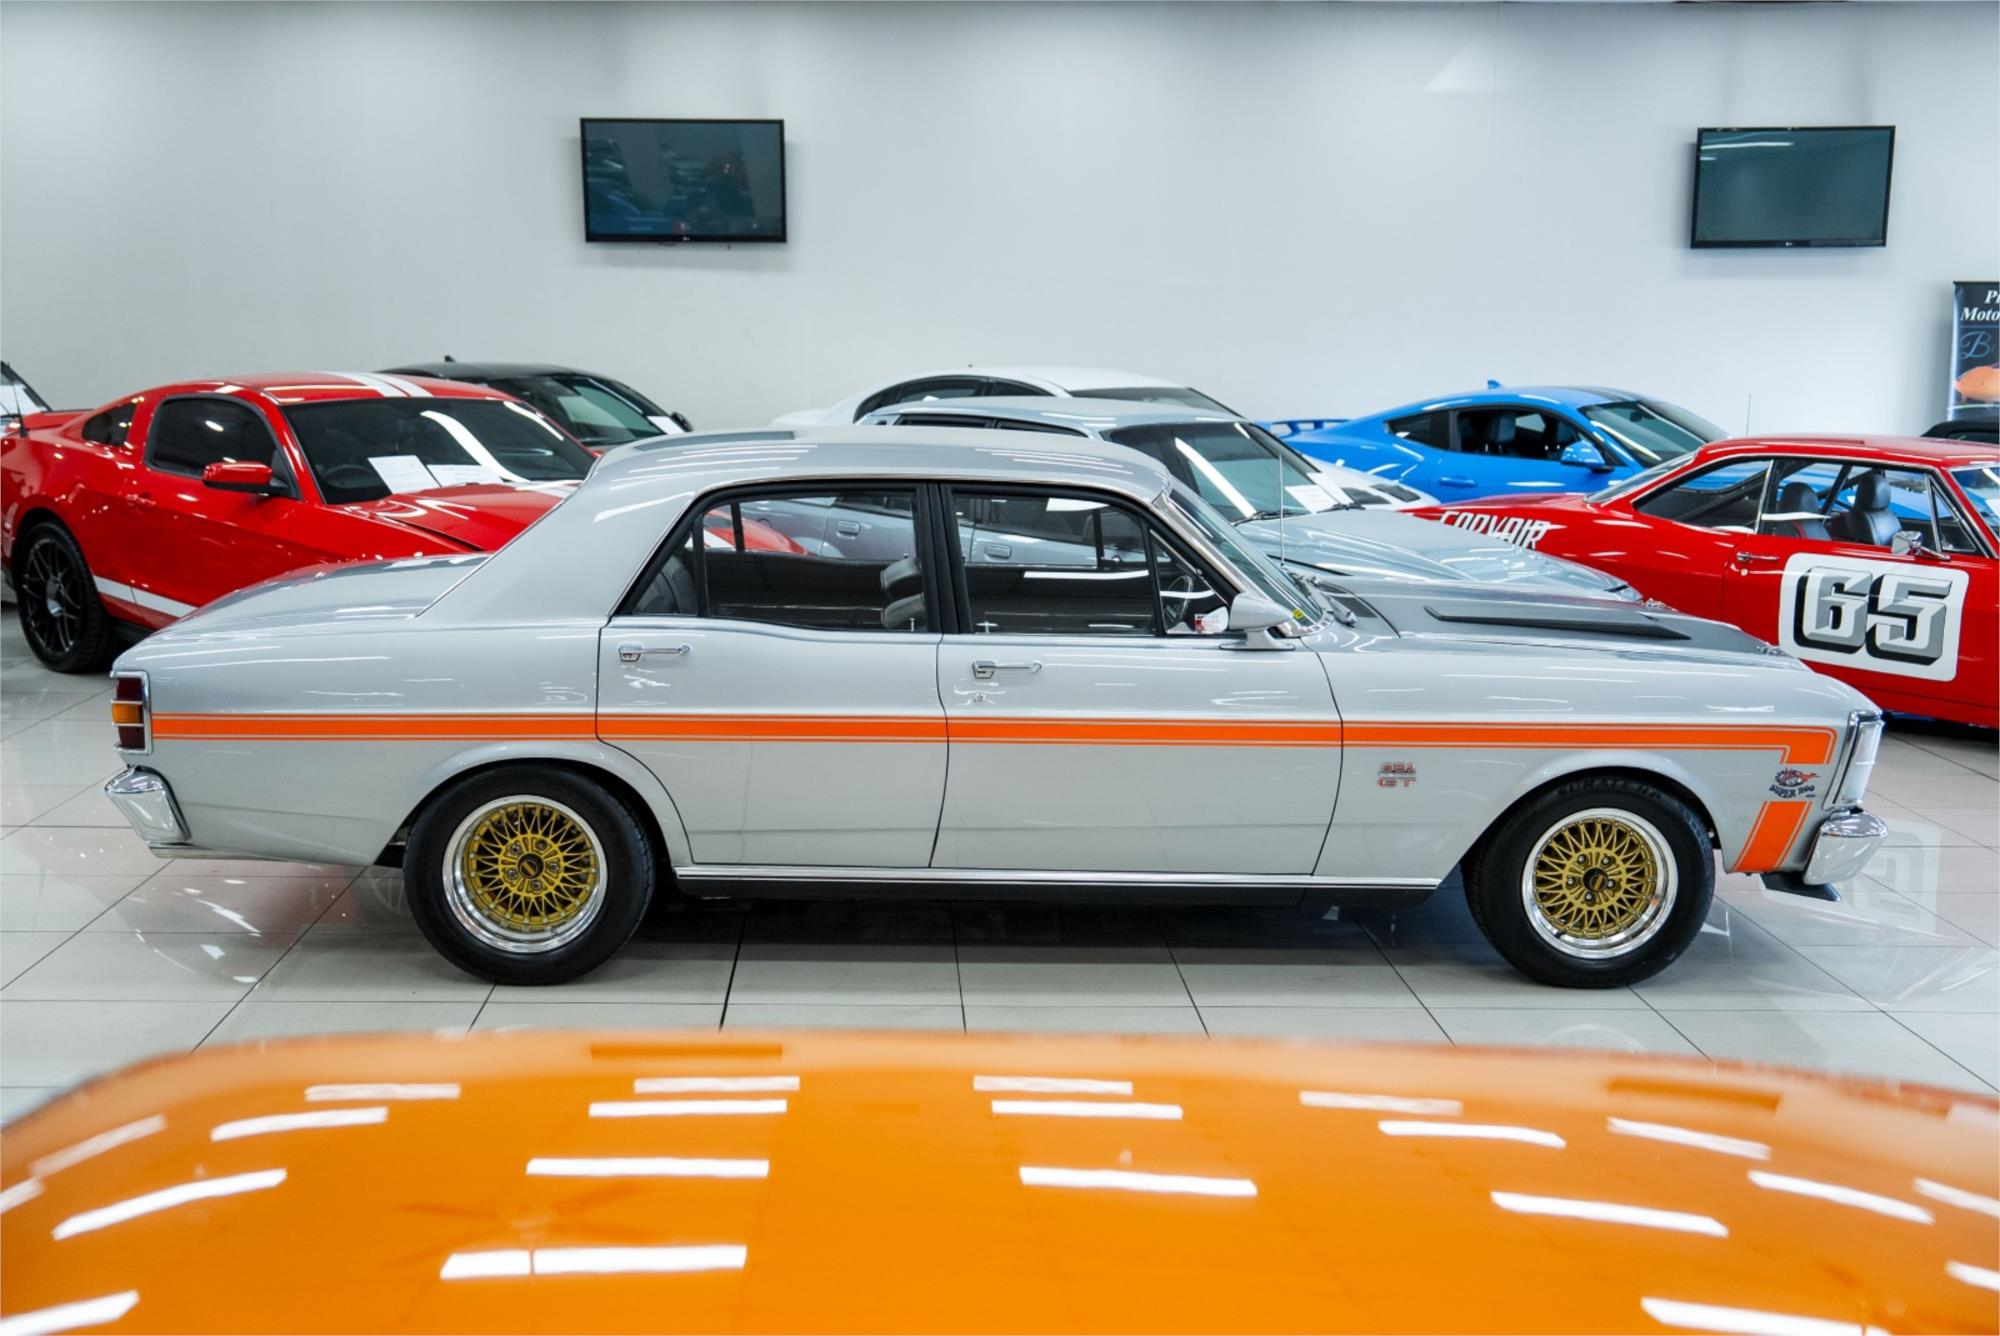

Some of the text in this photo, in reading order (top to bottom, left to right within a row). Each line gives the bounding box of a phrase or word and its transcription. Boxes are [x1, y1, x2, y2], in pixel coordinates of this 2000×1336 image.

[1794, 566, 1952, 666] 65
[1377, 776, 1416, 788] GT
[1769, 784, 1797, 798] SUPER
